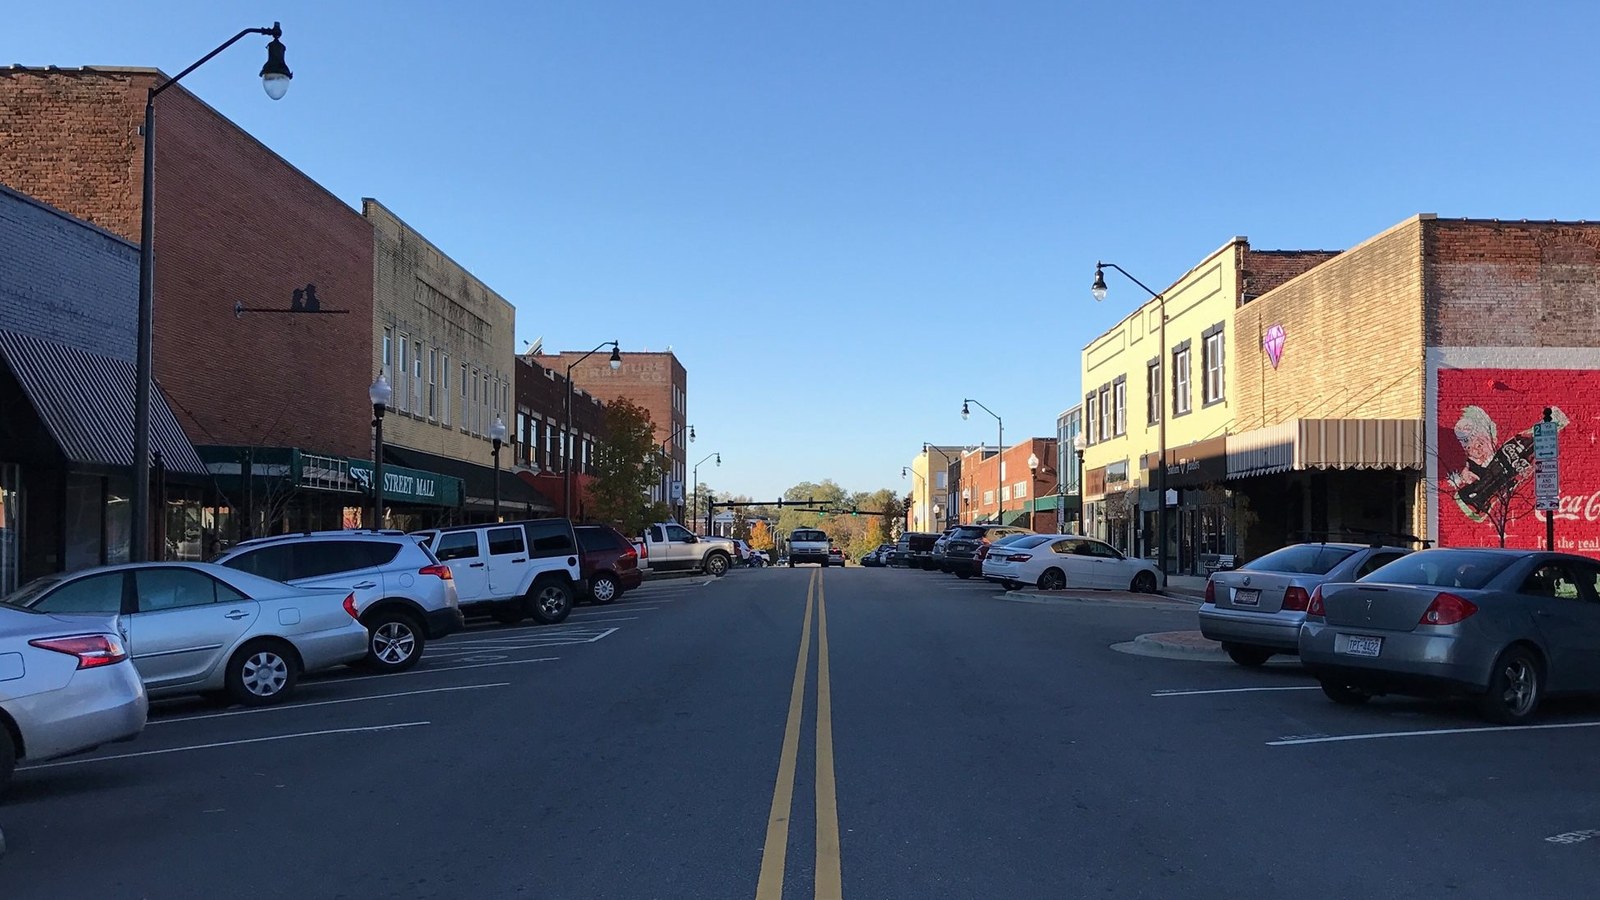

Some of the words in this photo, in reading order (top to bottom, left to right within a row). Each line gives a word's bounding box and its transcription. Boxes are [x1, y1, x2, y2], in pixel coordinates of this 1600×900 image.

[1535, 425, 1541, 435] 2
[384, 473, 414, 494] STREET
[416, 478, 435, 496] MALL
[1557, 536, 1575, 549] the
[1578, 536, 1599, 549] real
